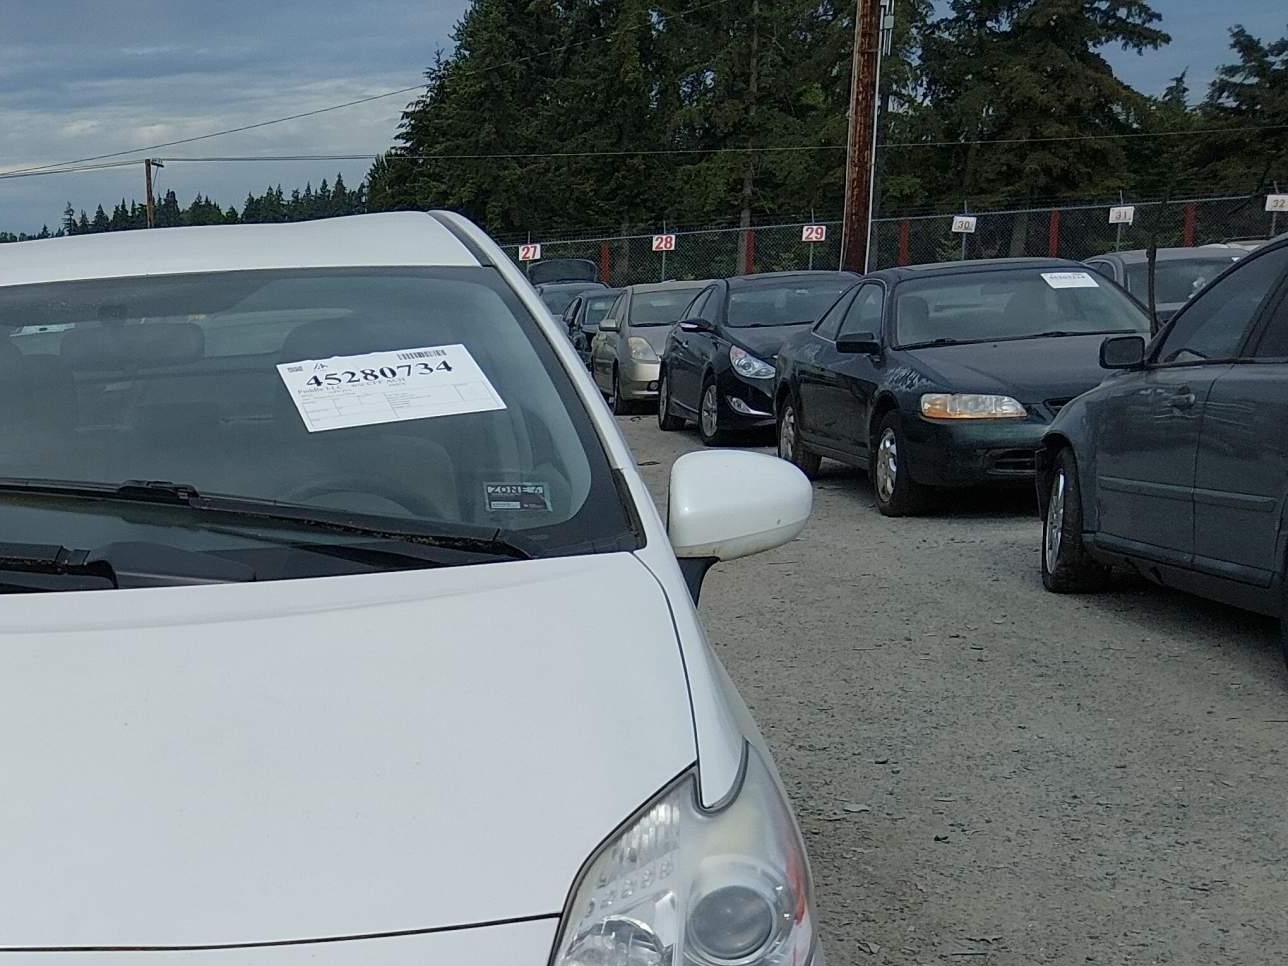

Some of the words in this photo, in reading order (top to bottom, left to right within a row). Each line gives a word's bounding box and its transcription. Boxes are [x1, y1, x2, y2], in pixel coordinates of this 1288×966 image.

[1273, 199, 1286, 208] 32
[1115, 211, 1127, 220] 31
[958, 221, 970, 230] 30
[805, 227, 823, 240] 29
[655, 236, 673, 249] 28
[521, 246, 536, 259] 27
[306, 360, 453, 387] 45280734
